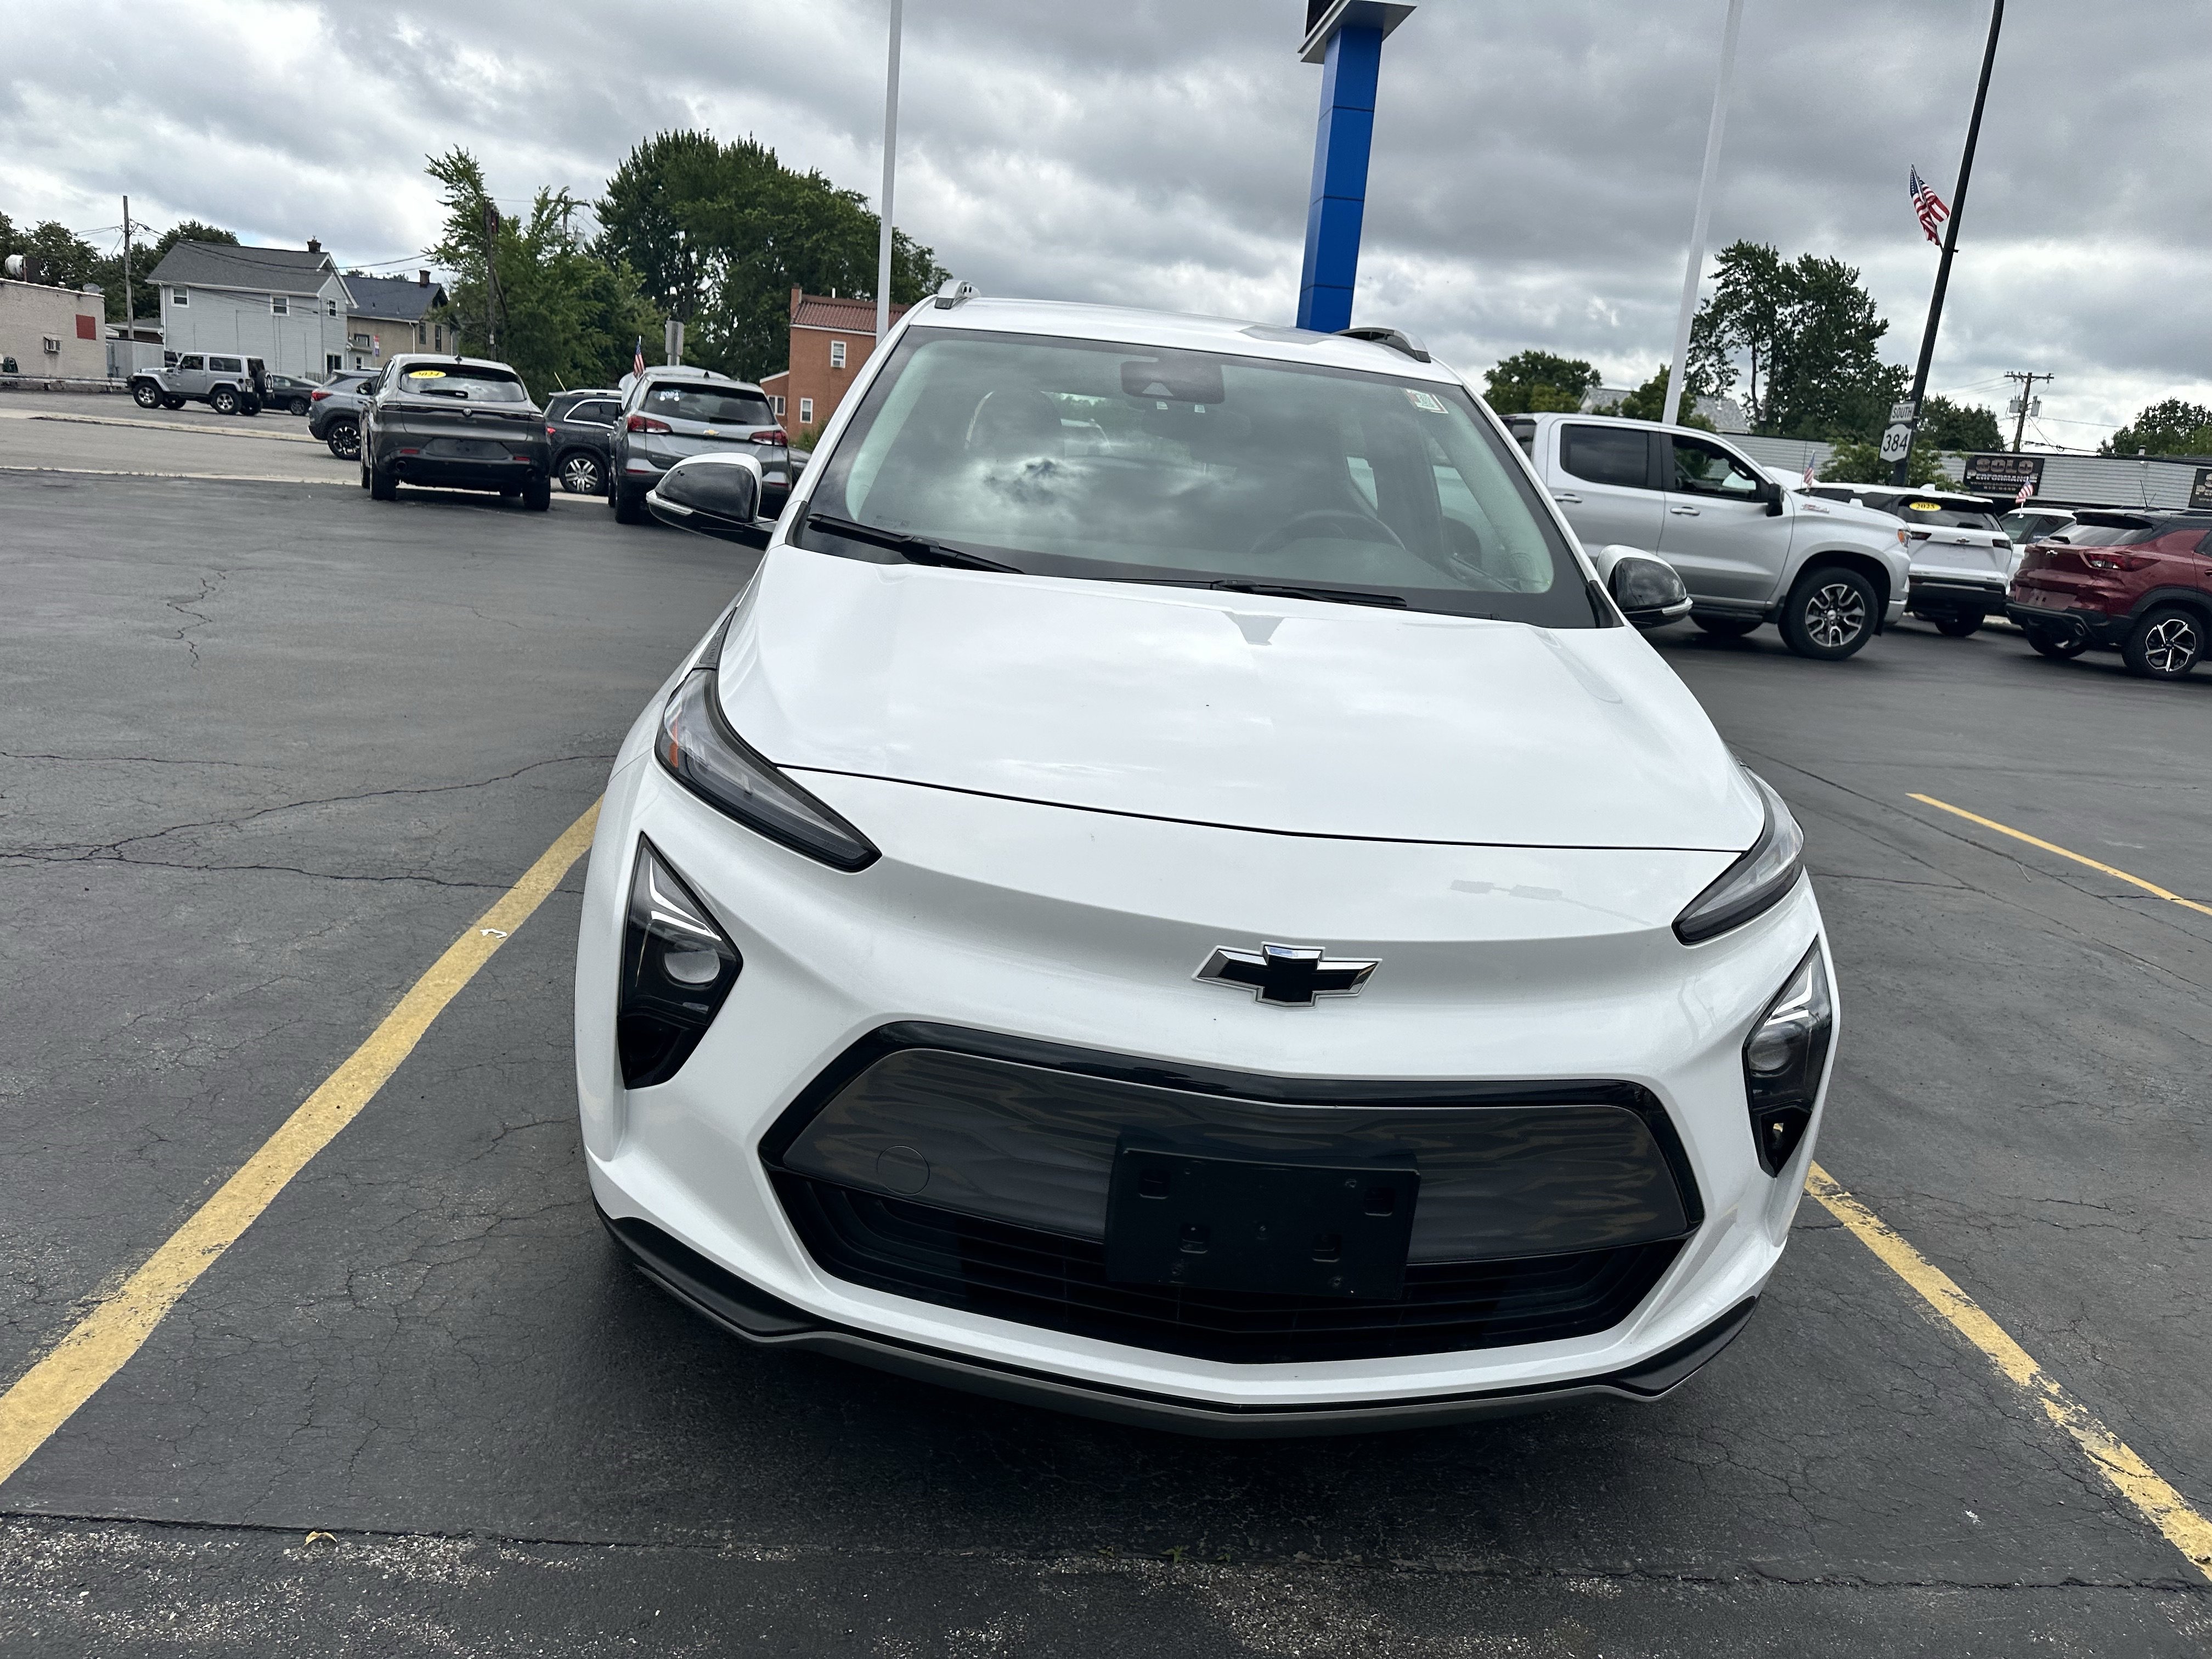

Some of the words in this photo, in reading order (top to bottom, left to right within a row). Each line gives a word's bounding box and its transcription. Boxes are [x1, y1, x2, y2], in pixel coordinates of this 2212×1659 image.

[1892, 407, 1912, 419] SOUTH
[1883, 433, 1909, 452] 384
[1976, 458, 2034, 475] SOLO
